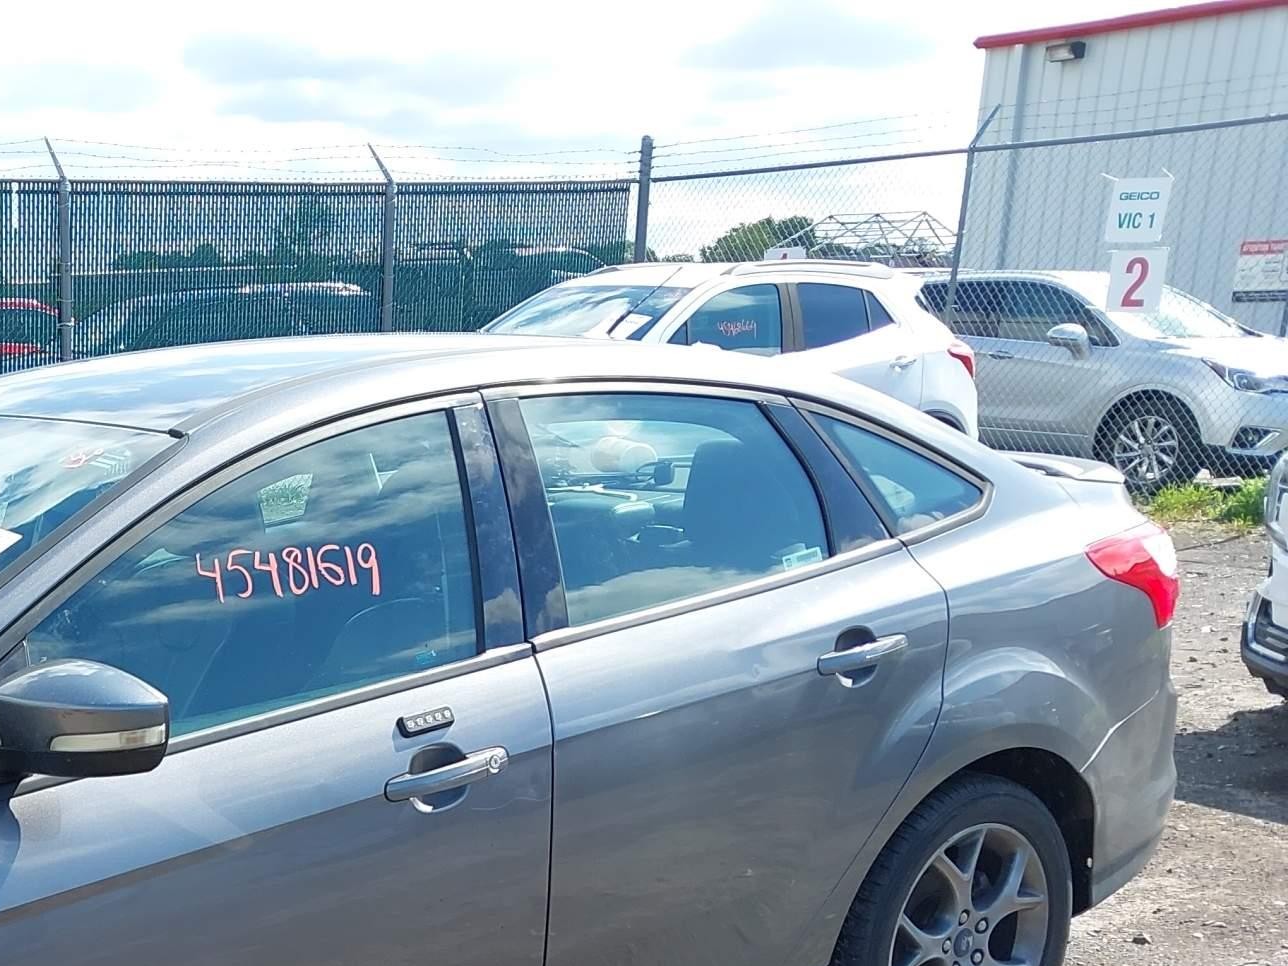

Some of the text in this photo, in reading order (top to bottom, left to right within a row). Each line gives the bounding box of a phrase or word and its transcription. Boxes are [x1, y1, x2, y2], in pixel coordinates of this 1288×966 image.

[1119, 191, 1160, 201] GEICO
[1118, 211, 1156, 229] VIC 1
[1120, 256, 1150, 308] 2
[195, 542, 381, 604] 45481619
